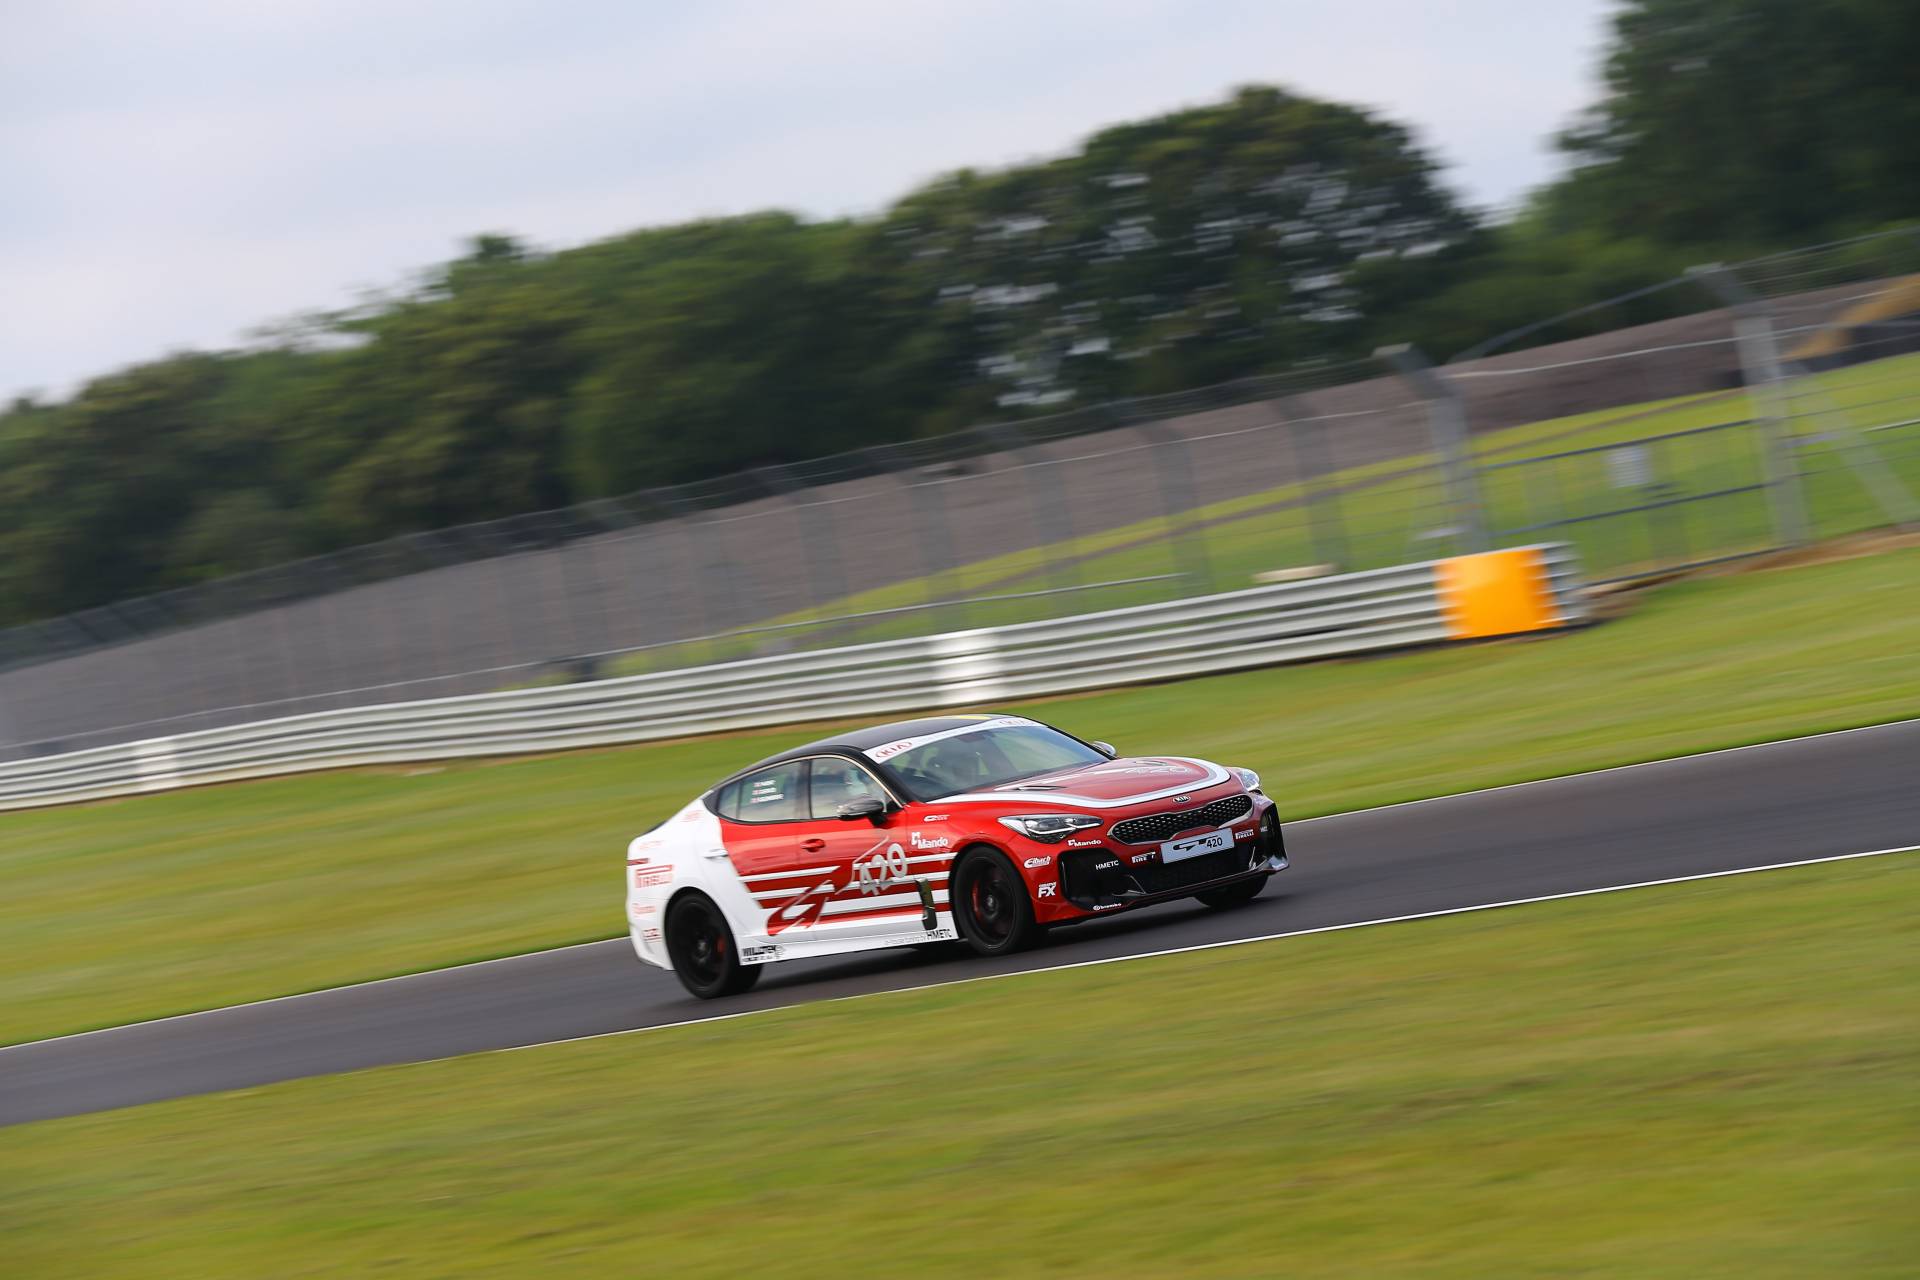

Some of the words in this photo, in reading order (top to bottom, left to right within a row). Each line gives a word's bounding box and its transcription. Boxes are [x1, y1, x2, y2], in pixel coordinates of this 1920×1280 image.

[879, 743, 908, 757] KIA
[917, 837, 949, 849] Mando
[1074, 839, 1102, 847] Mando
[1206, 836, 1223, 848] 420
[860, 843, 908, 896] 420
[1095, 859, 1120, 870] HMETC
[1038, 886, 1056, 898] FX
